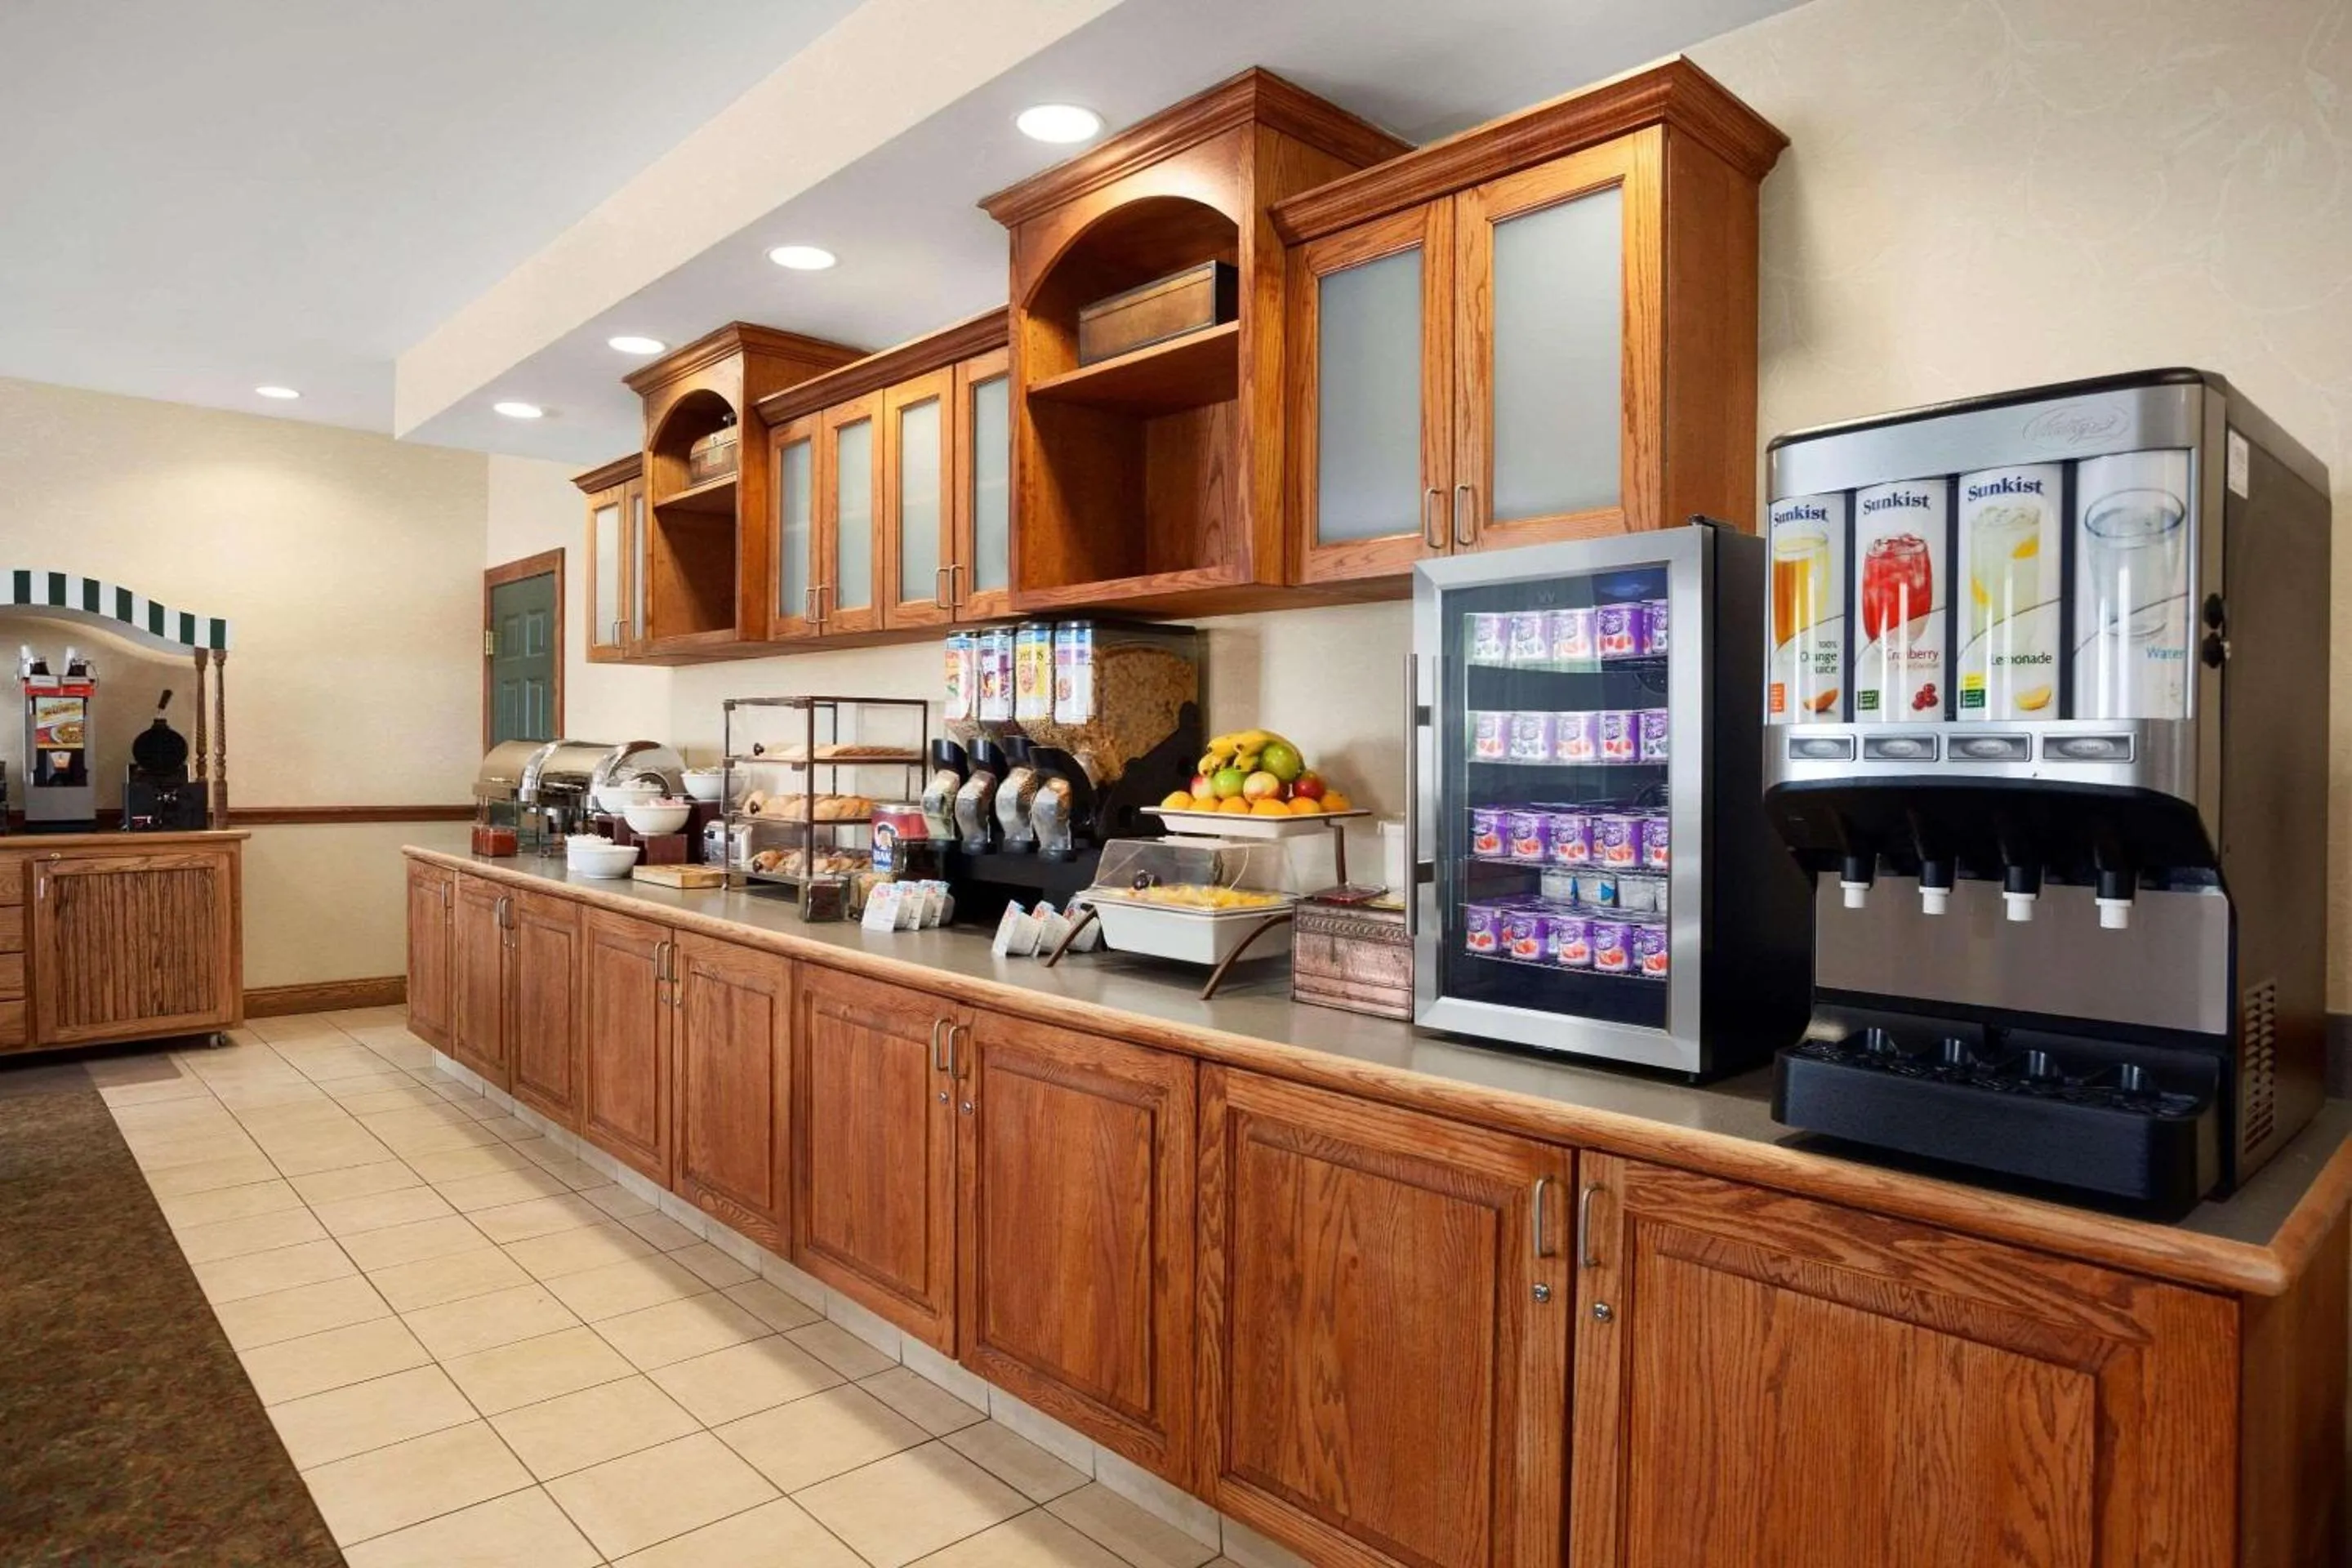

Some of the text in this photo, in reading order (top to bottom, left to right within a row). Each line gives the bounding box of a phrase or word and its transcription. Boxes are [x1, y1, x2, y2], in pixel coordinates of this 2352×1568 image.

[1967, 475, 2045, 502] Sunkist
[1863, 490, 1931, 514] Sunkist
[1773, 505, 1829, 527] Sunkist
[1800, 651, 1838, 664] Onge
[1886, 646, 1939, 662] Crberry
[2146, 644, 2186, 659] Water
[1814, 666, 1838, 675] uice
